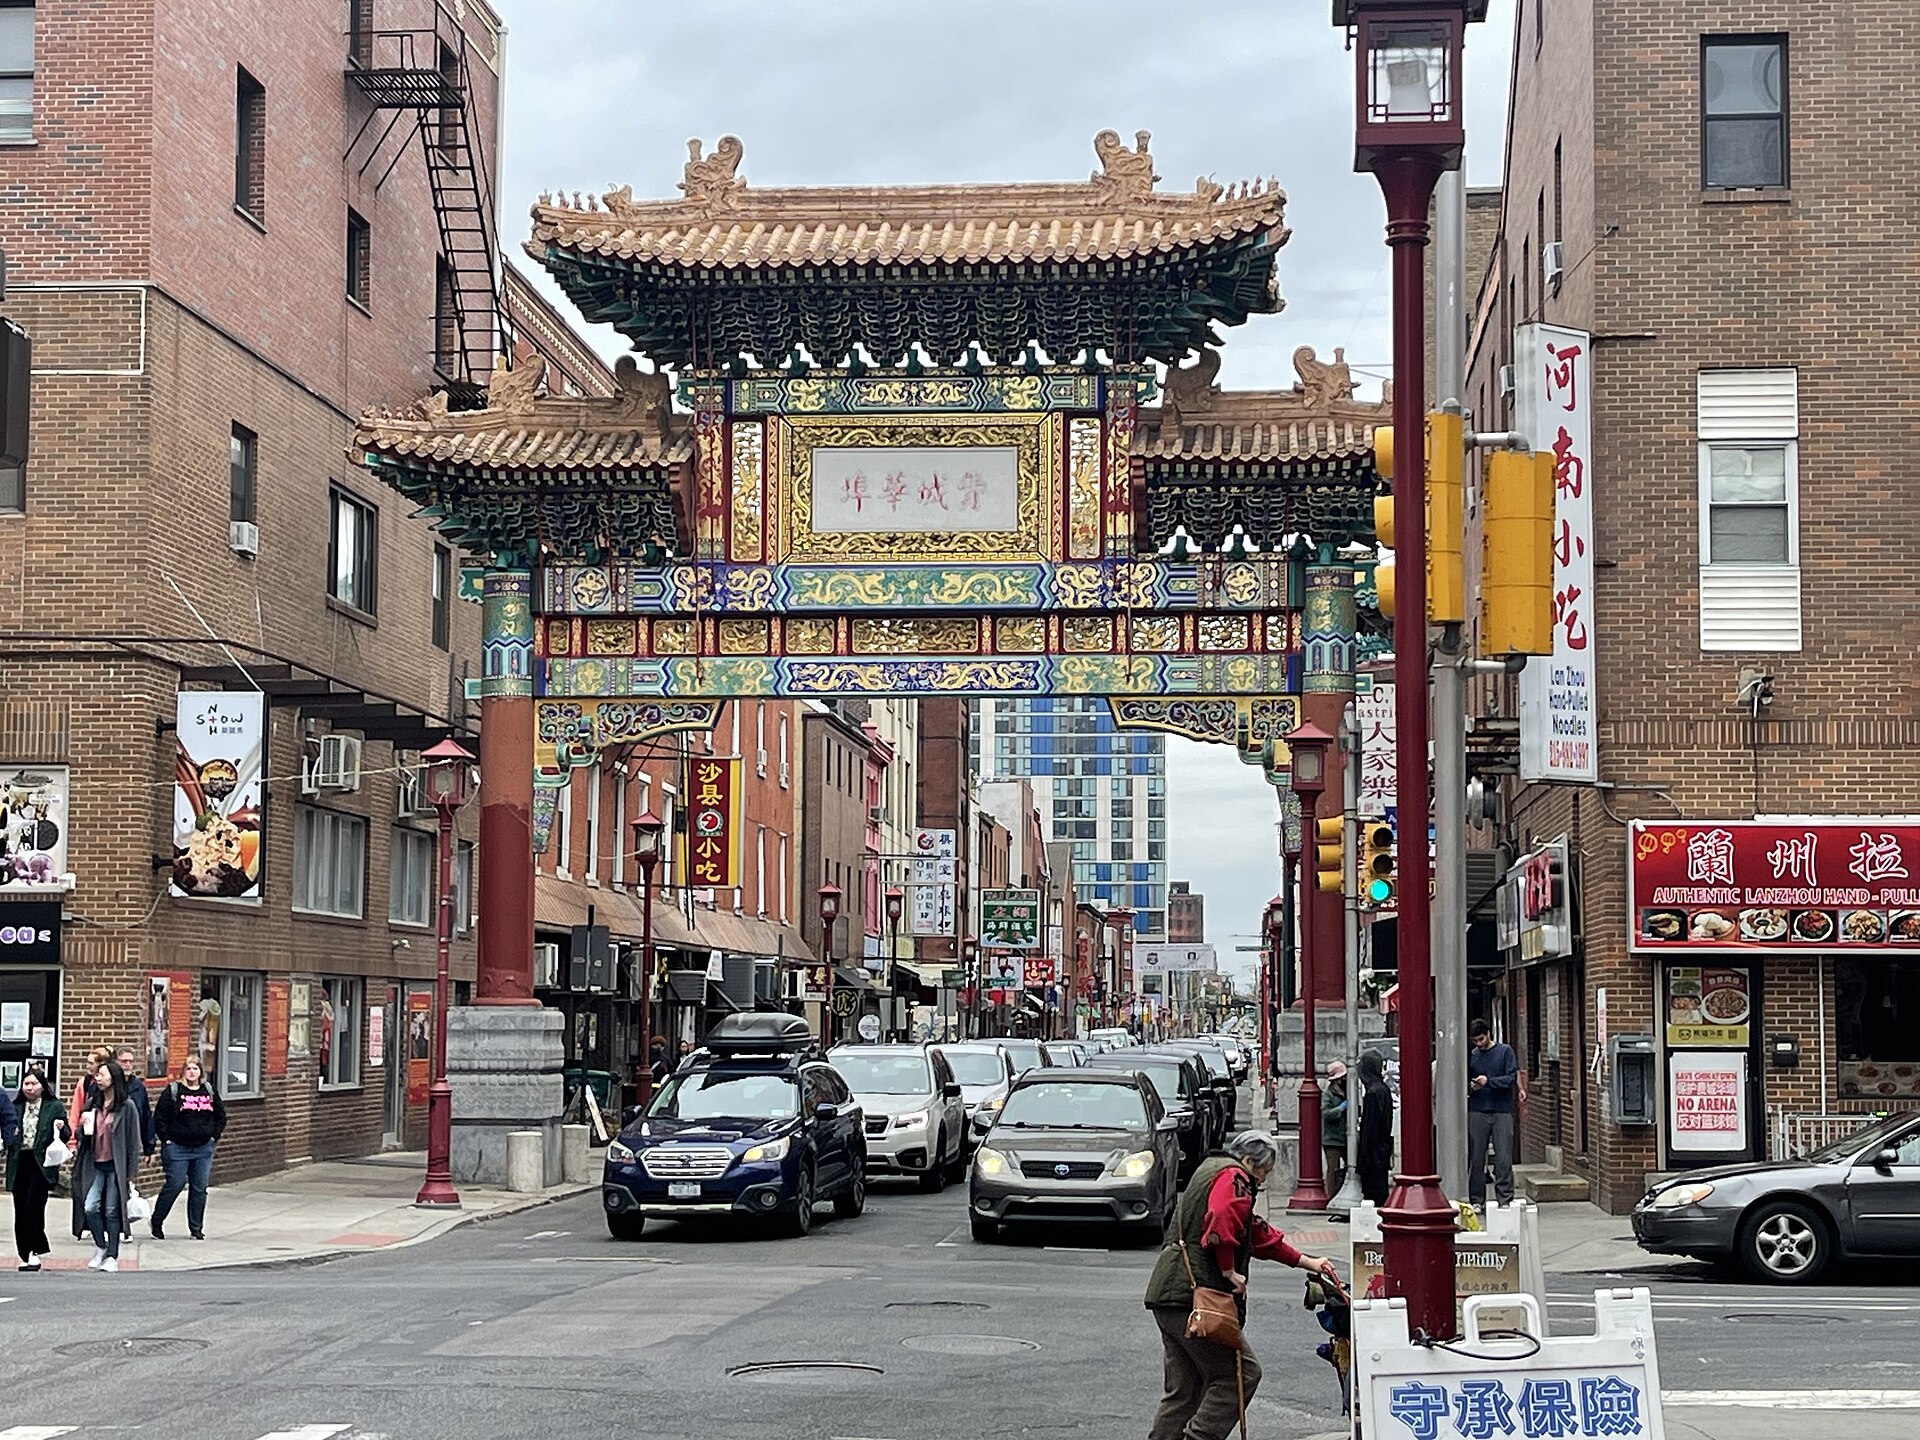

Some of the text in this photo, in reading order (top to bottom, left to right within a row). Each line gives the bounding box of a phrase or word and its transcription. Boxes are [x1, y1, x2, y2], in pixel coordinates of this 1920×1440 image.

[1552, 714, 1586, 736] Noodles
[696, 763, 723, 882] 沙县小吃
[1688, 829, 1909, 886] 蘭州拉
[1653, 887, 1741, 905] AUTHENTIC
[1745, 887, 1821, 905] LANZHOU
[1677, 1097, 1737, 1111] NO ARENA
[1463, 1251, 1507, 1271] Philly
[1389, 1376, 1644, 1440] 守承保險
